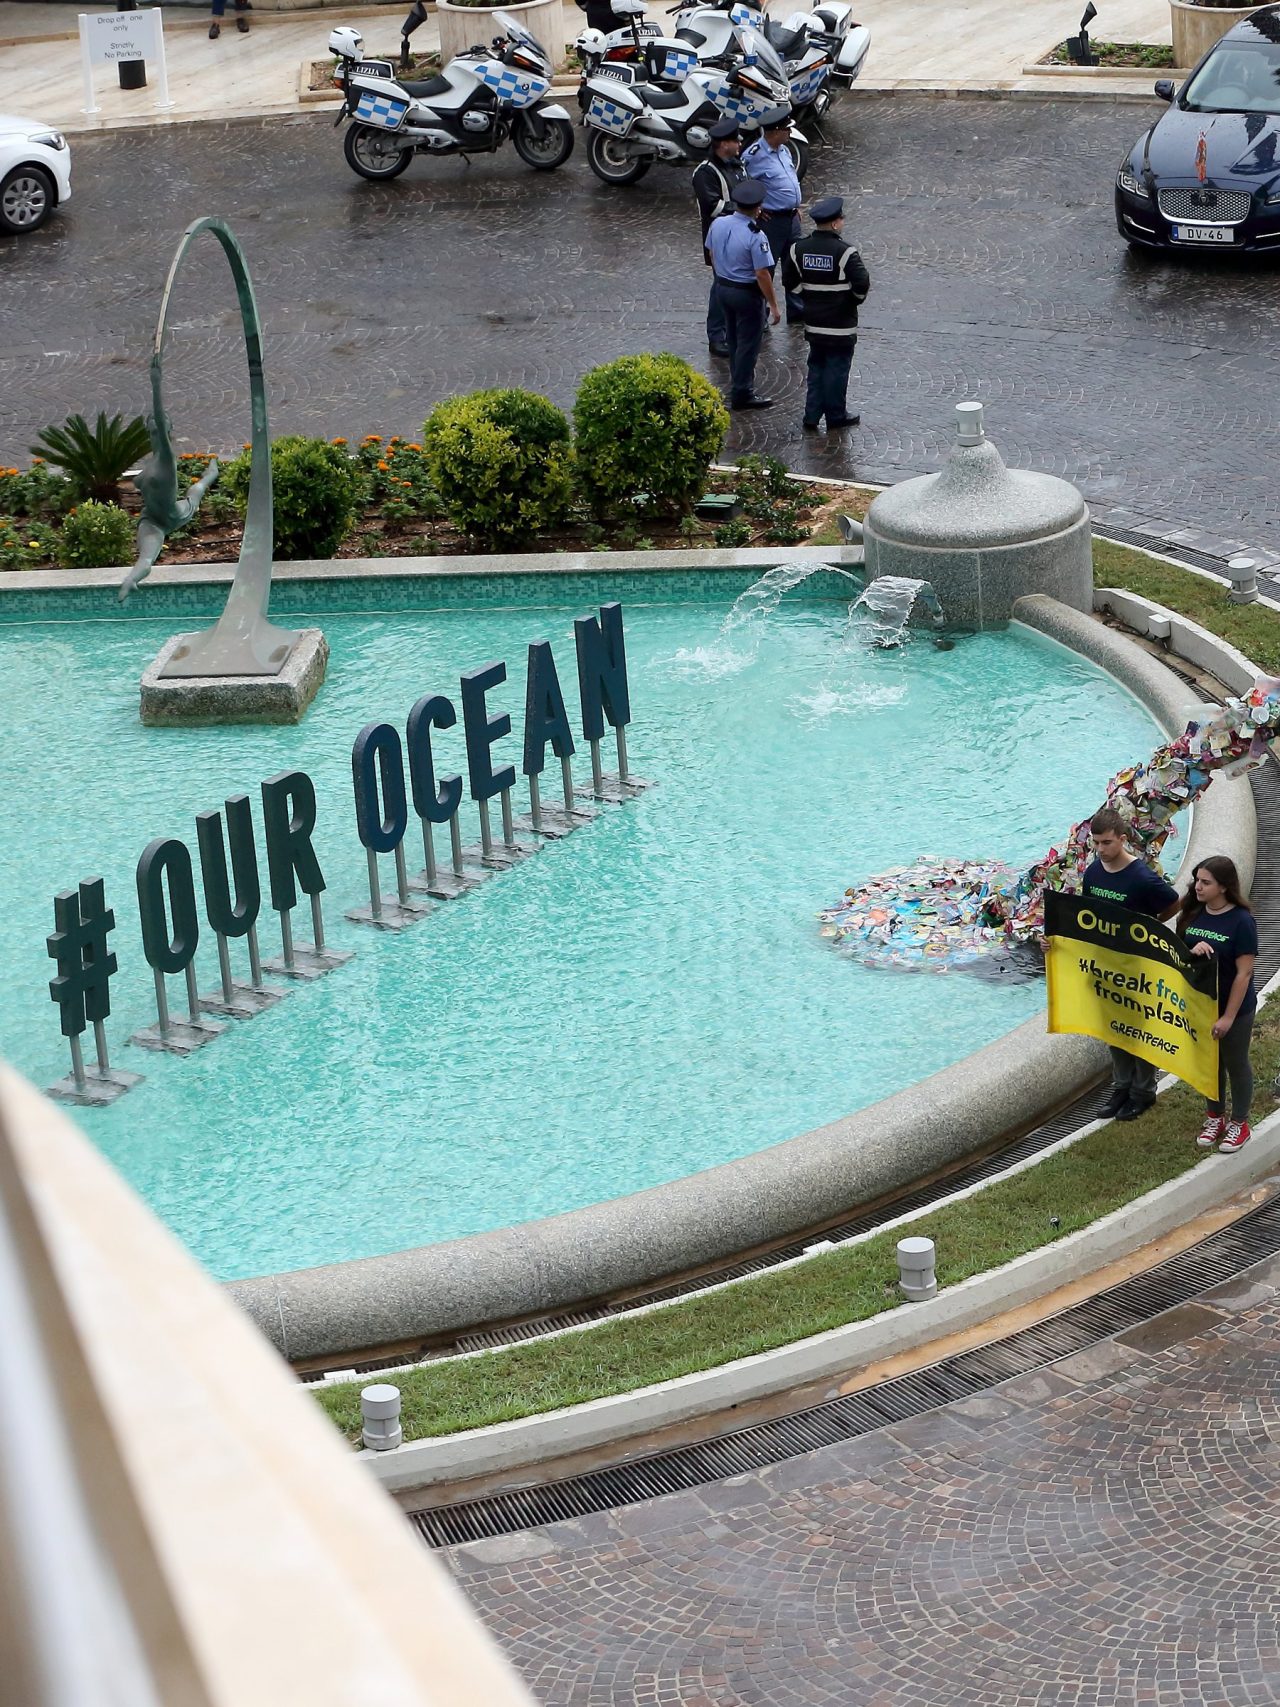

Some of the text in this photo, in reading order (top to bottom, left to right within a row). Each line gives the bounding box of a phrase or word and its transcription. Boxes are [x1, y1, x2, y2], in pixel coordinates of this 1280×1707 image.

[97, 16, 115, 24] Drop
[110, 42, 135, 50] Strictly
[116, 50, 142, 58] Parking
[804, 256, 831, 268] PULIZIJA
[352, 602, 631, 853] OCEAN
[1077, 909, 1121, 937] Our
[1110, 1020, 1180, 1055] GREENPEACE
